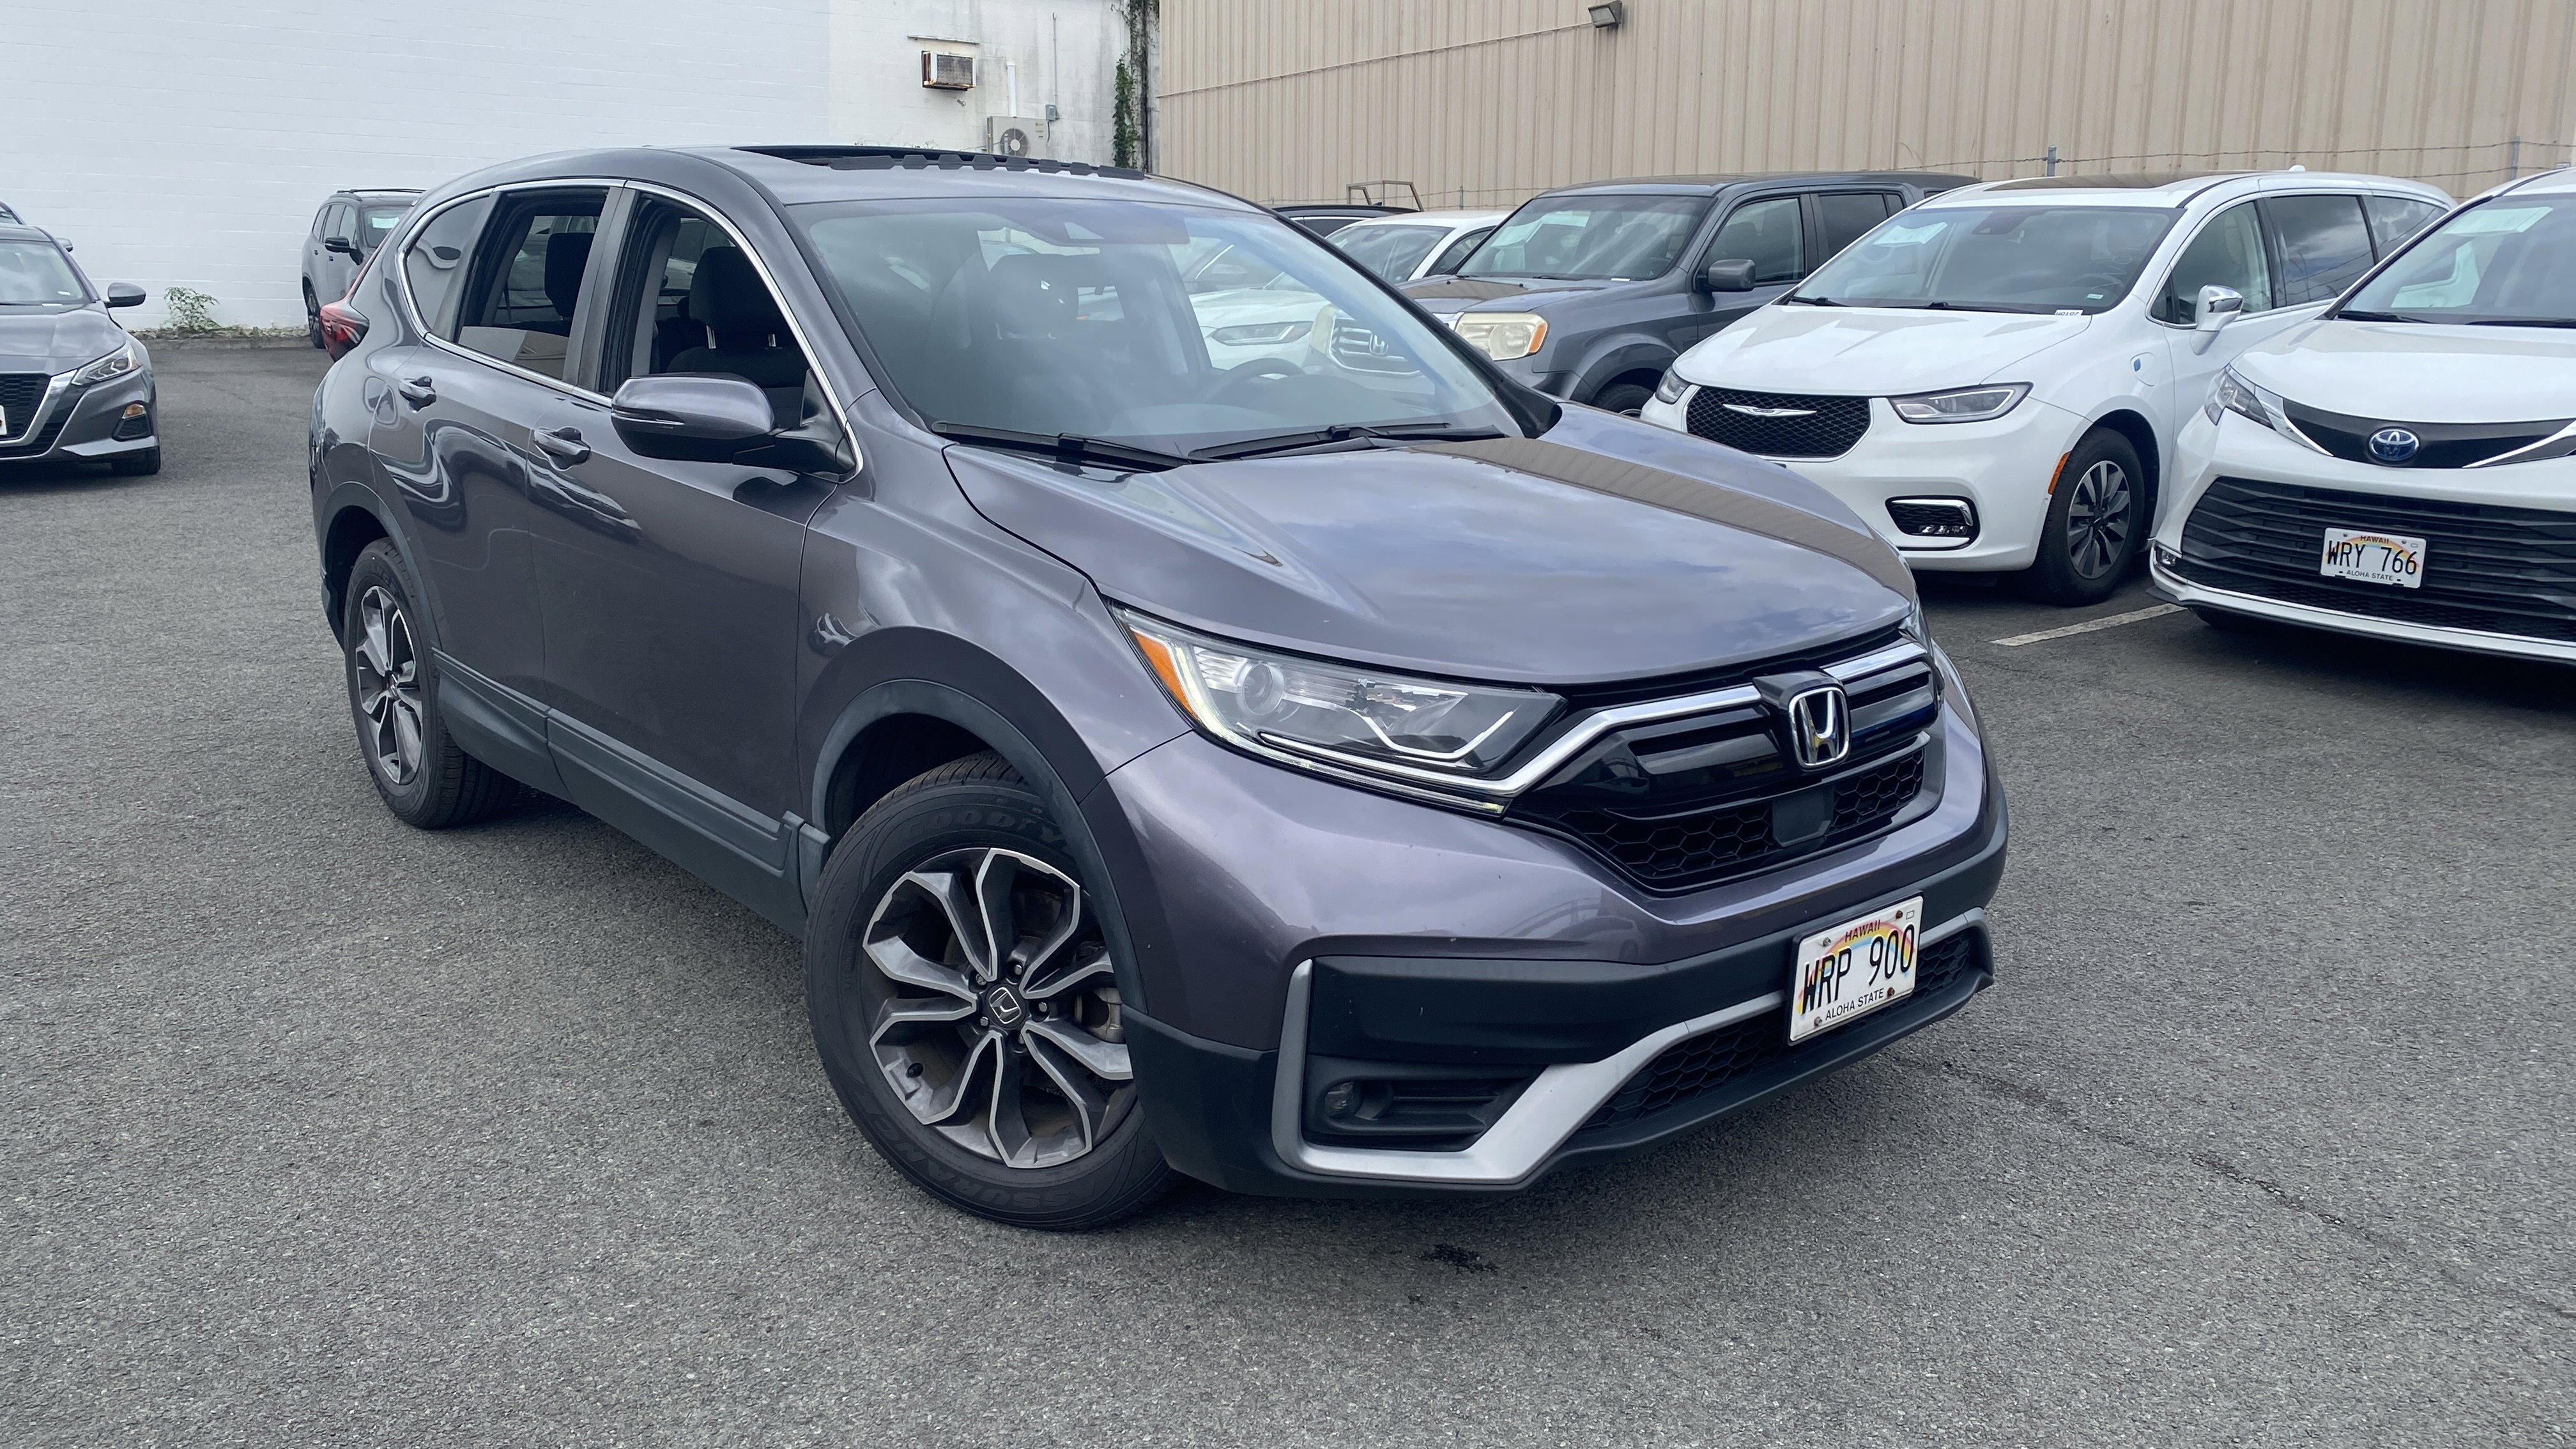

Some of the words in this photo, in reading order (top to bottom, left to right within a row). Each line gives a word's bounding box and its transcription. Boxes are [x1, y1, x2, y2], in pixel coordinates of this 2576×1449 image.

[2360, 535, 2389, 544] HAWAII
[2327, 540, 2366, 568] WRY
[2380, 546, 2418, 575] 766
[2346, 569, 2369, 578] ALOHA
[2372, 573, 2394, 581] STATE
[1844, 919, 1881, 943] HAWAII
[1800, 948, 1851, 1015] WRP
[1868, 924, 1915, 986] 900
[1825, 1000, 1855, 1021] ALOHA
[1857, 988, 1885, 1008] STATE
